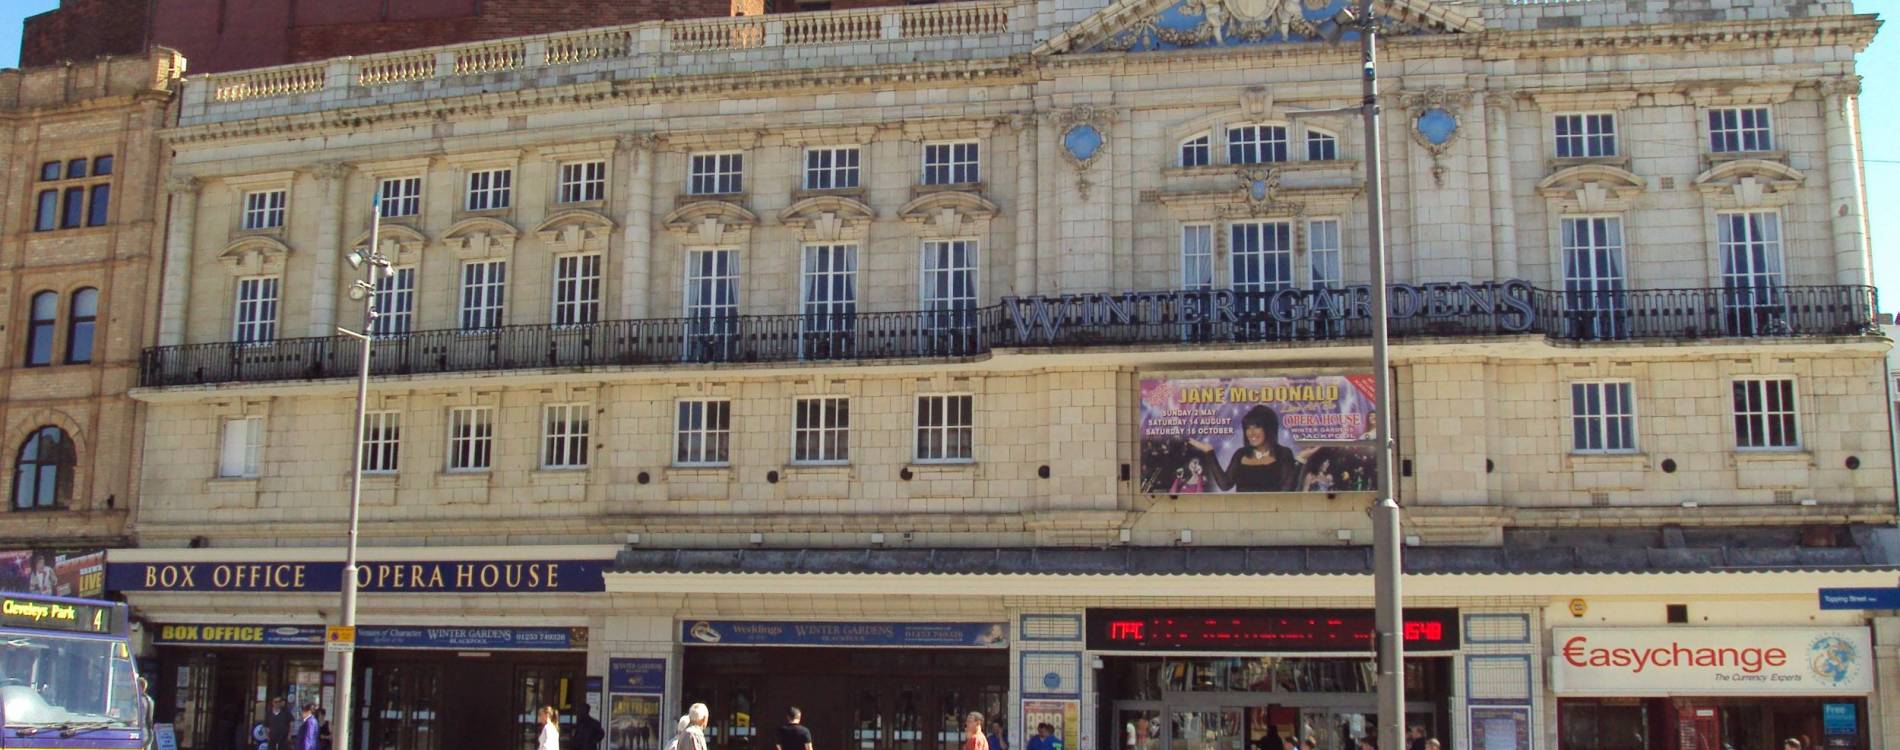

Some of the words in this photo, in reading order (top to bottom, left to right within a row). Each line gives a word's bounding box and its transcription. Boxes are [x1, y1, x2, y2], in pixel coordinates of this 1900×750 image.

[1001, 289, 1233, 343] WINTER
[1270, 279, 1536, 331] GARDENS
[1179, 386, 1226, 404] JANE
[1230, 384, 1339, 403] McDONALD
[1162, 409, 1191, 417] SUNDAY
[1284, 414, 1319, 427] OPERA
[1320, 413, 1360, 426] HOUSE
[1148, 418, 1186, 426] SATURDAY
[145, 565, 195, 588] BOX
[213, 565, 306, 588] OFFICE
[357, 564, 444, 588] OPERA
[456, 563, 558, 588] HOUSE
[51, 604, 75, 619] Park
[93, 609, 103, 631] 4
[162, 626, 199, 640] BOX
[202, 627, 264, 641] OFFICE
[428, 629, 467, 640] WINTER
[468, 629, 512, 640] GARDENS
[733, 625, 783, 635] Weddings
[795, 625, 840, 636] WINTER
[843, 625, 894, 637] GARDENS
[1732, 674, 1767, 682] Currency
[1770, 674, 1802, 682] Experts
